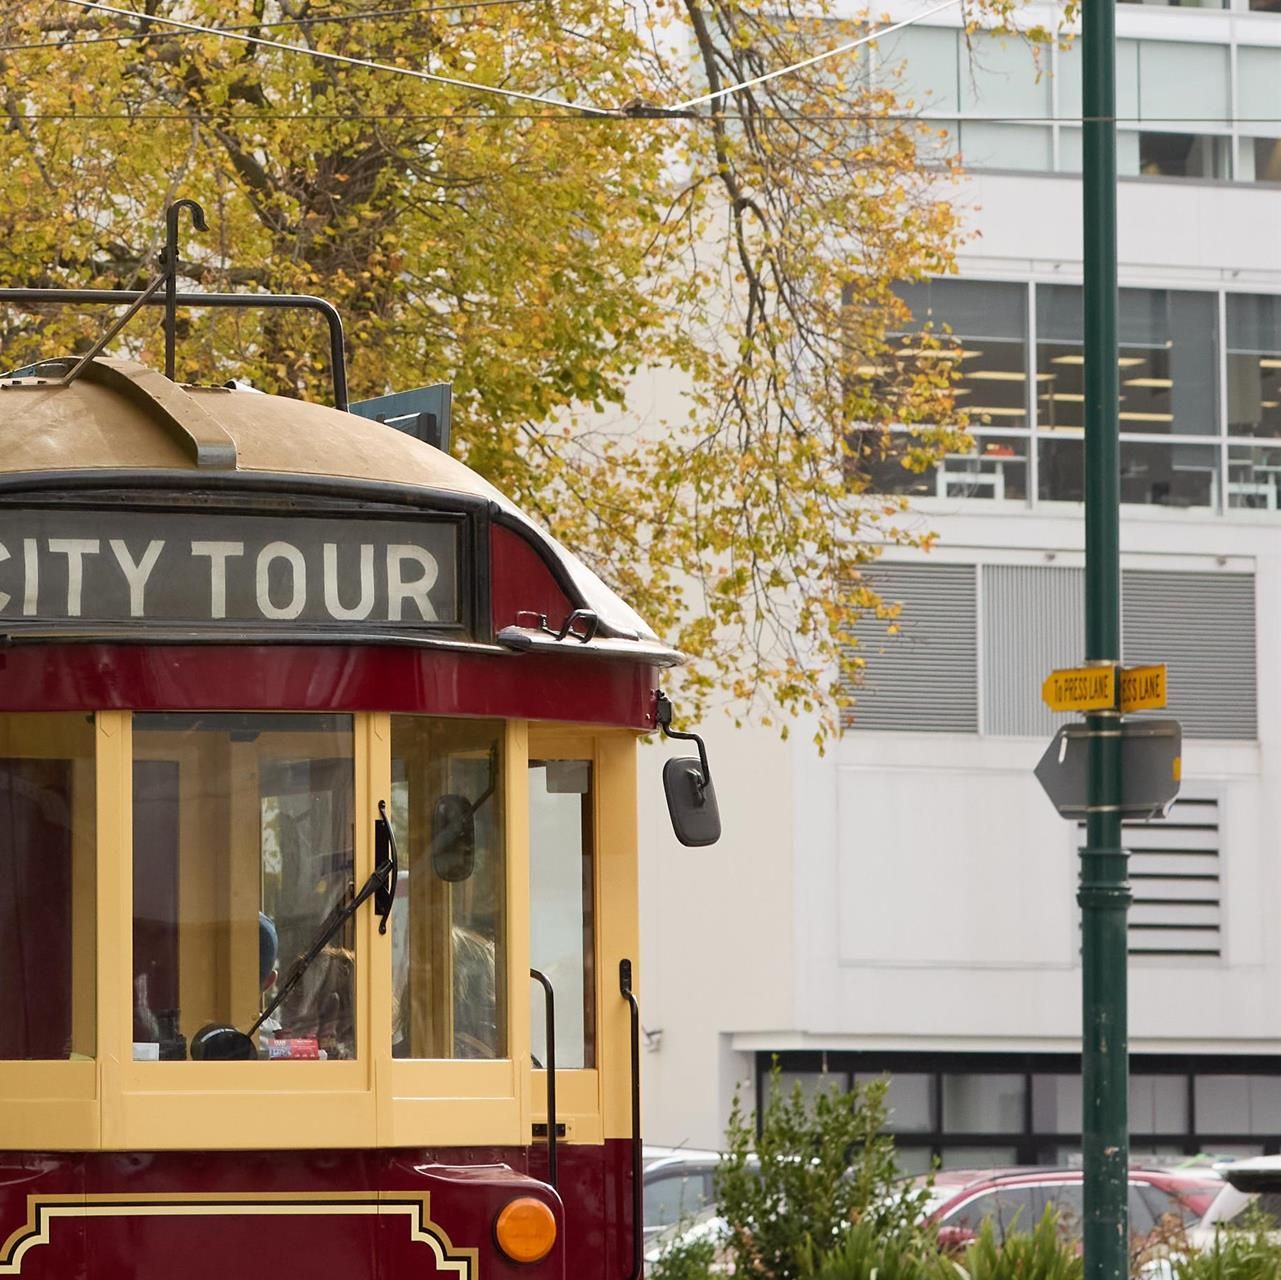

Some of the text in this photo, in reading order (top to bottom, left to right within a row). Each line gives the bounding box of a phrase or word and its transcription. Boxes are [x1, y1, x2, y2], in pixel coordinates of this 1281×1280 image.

[191, 540, 439, 621] TOUR
[1064, 677, 1088, 701] PRESS
[1089, 674, 1109, 699] LANE
[1139, 673, 1161, 700] LANE
